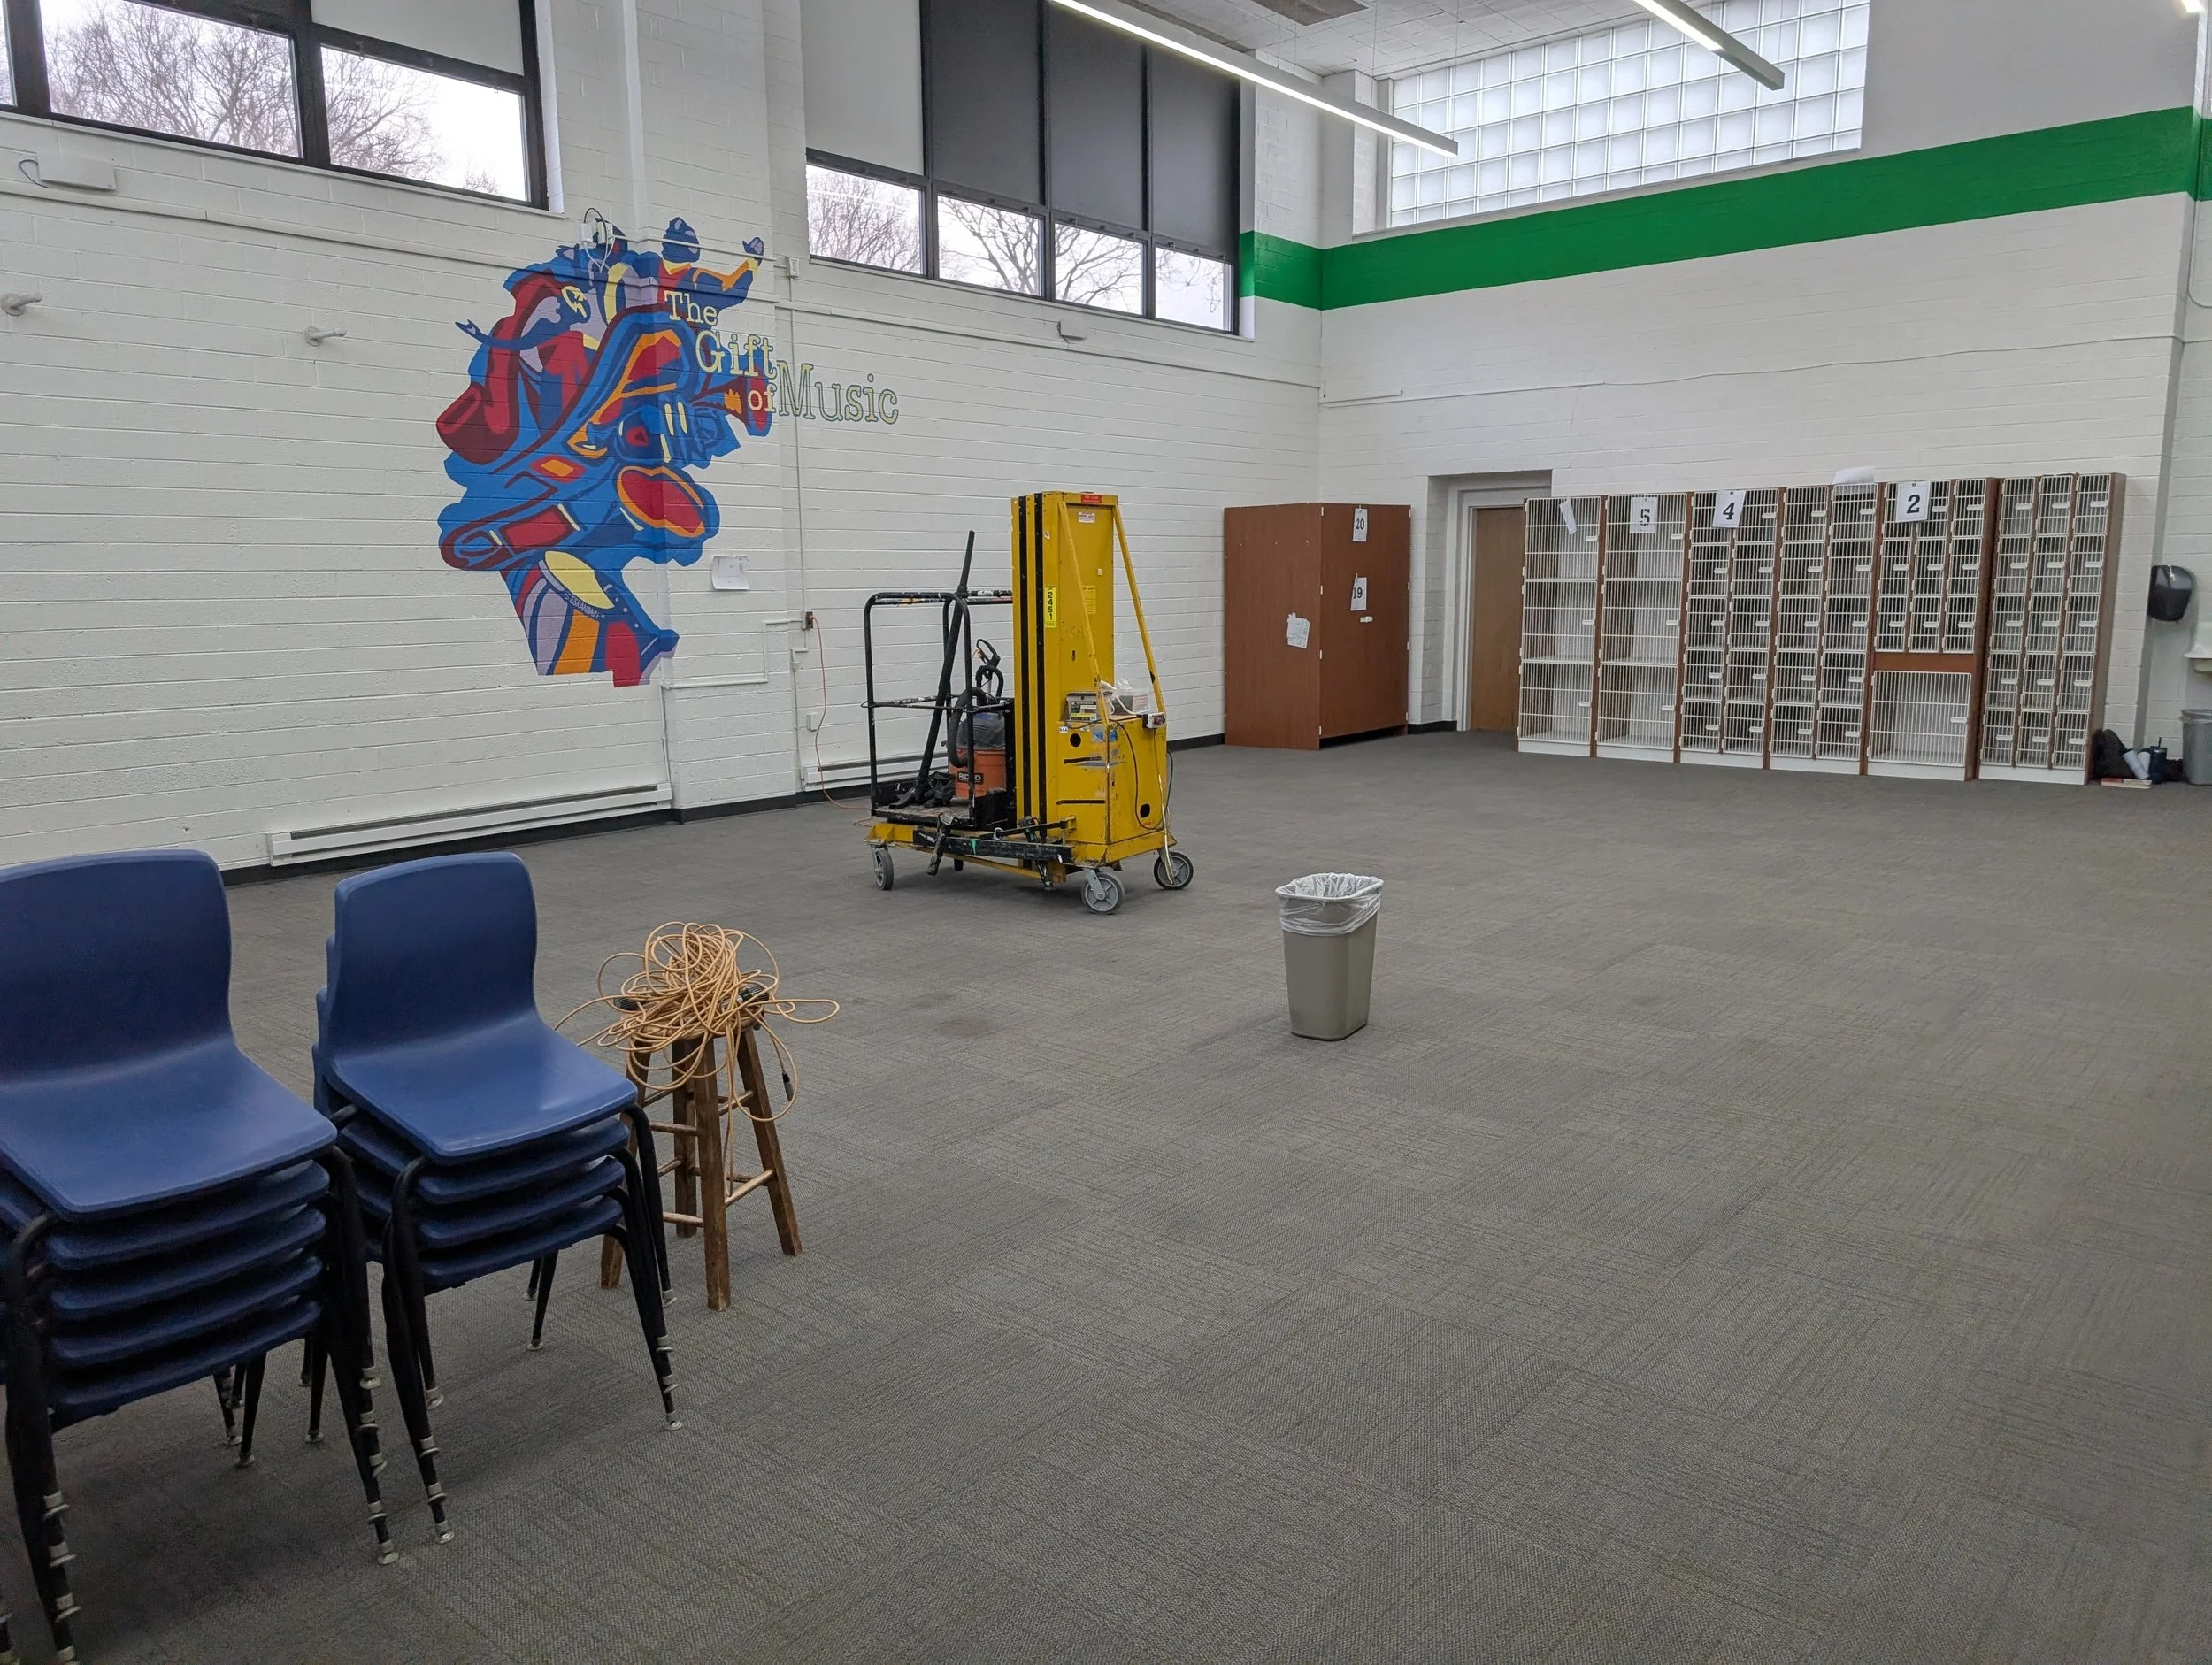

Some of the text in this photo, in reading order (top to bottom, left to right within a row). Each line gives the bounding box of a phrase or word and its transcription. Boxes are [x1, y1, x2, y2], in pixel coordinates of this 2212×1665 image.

[664, 289, 718, 326] The
[695, 329, 778, 380] Gift
[748, 359, 899, 425] of Music
[1723, 502, 1735, 520] 4
[1906, 494, 1921, 514] 2
[1356, 518, 1365, 530] 20
[1640, 509, 1651, 526] 5
[1353, 587, 1363, 599] 19
[958, 772, 982, 781] RIDD
